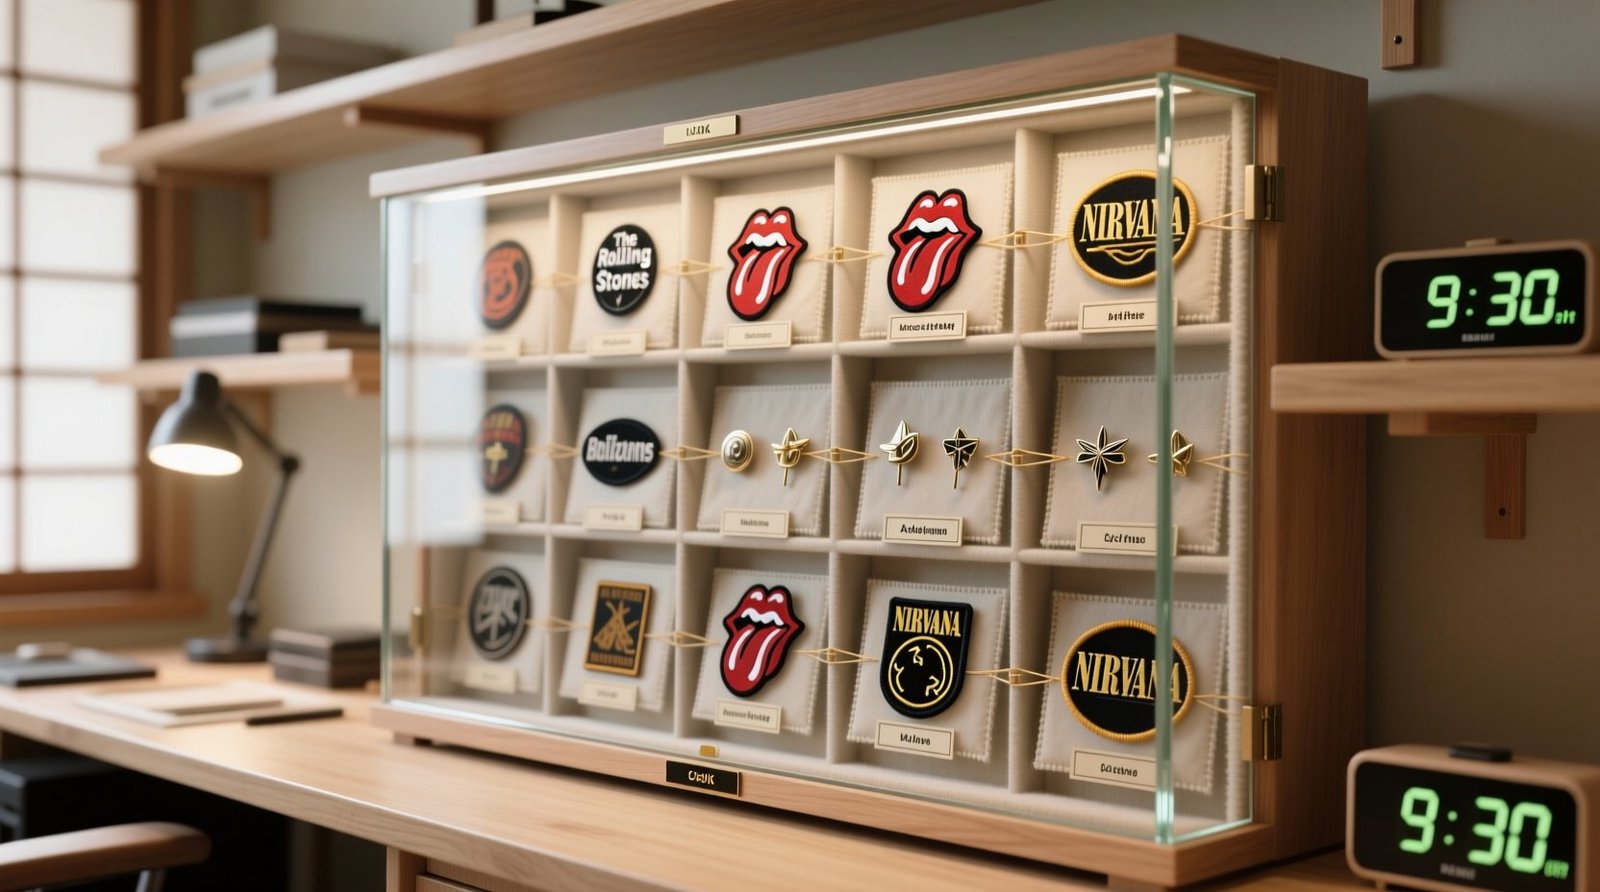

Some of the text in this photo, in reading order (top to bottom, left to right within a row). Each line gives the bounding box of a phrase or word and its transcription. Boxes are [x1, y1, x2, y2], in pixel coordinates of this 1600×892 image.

[612, 230, 639, 247] The
[597, 247, 652, 269] Rolling
[595, 269, 650, 293] Stones
[1426, 268, 1560, 329] 9:30
[892, 605, 962, 638] NIRVANA
[1399, 786, 1553, 875] 9:30
